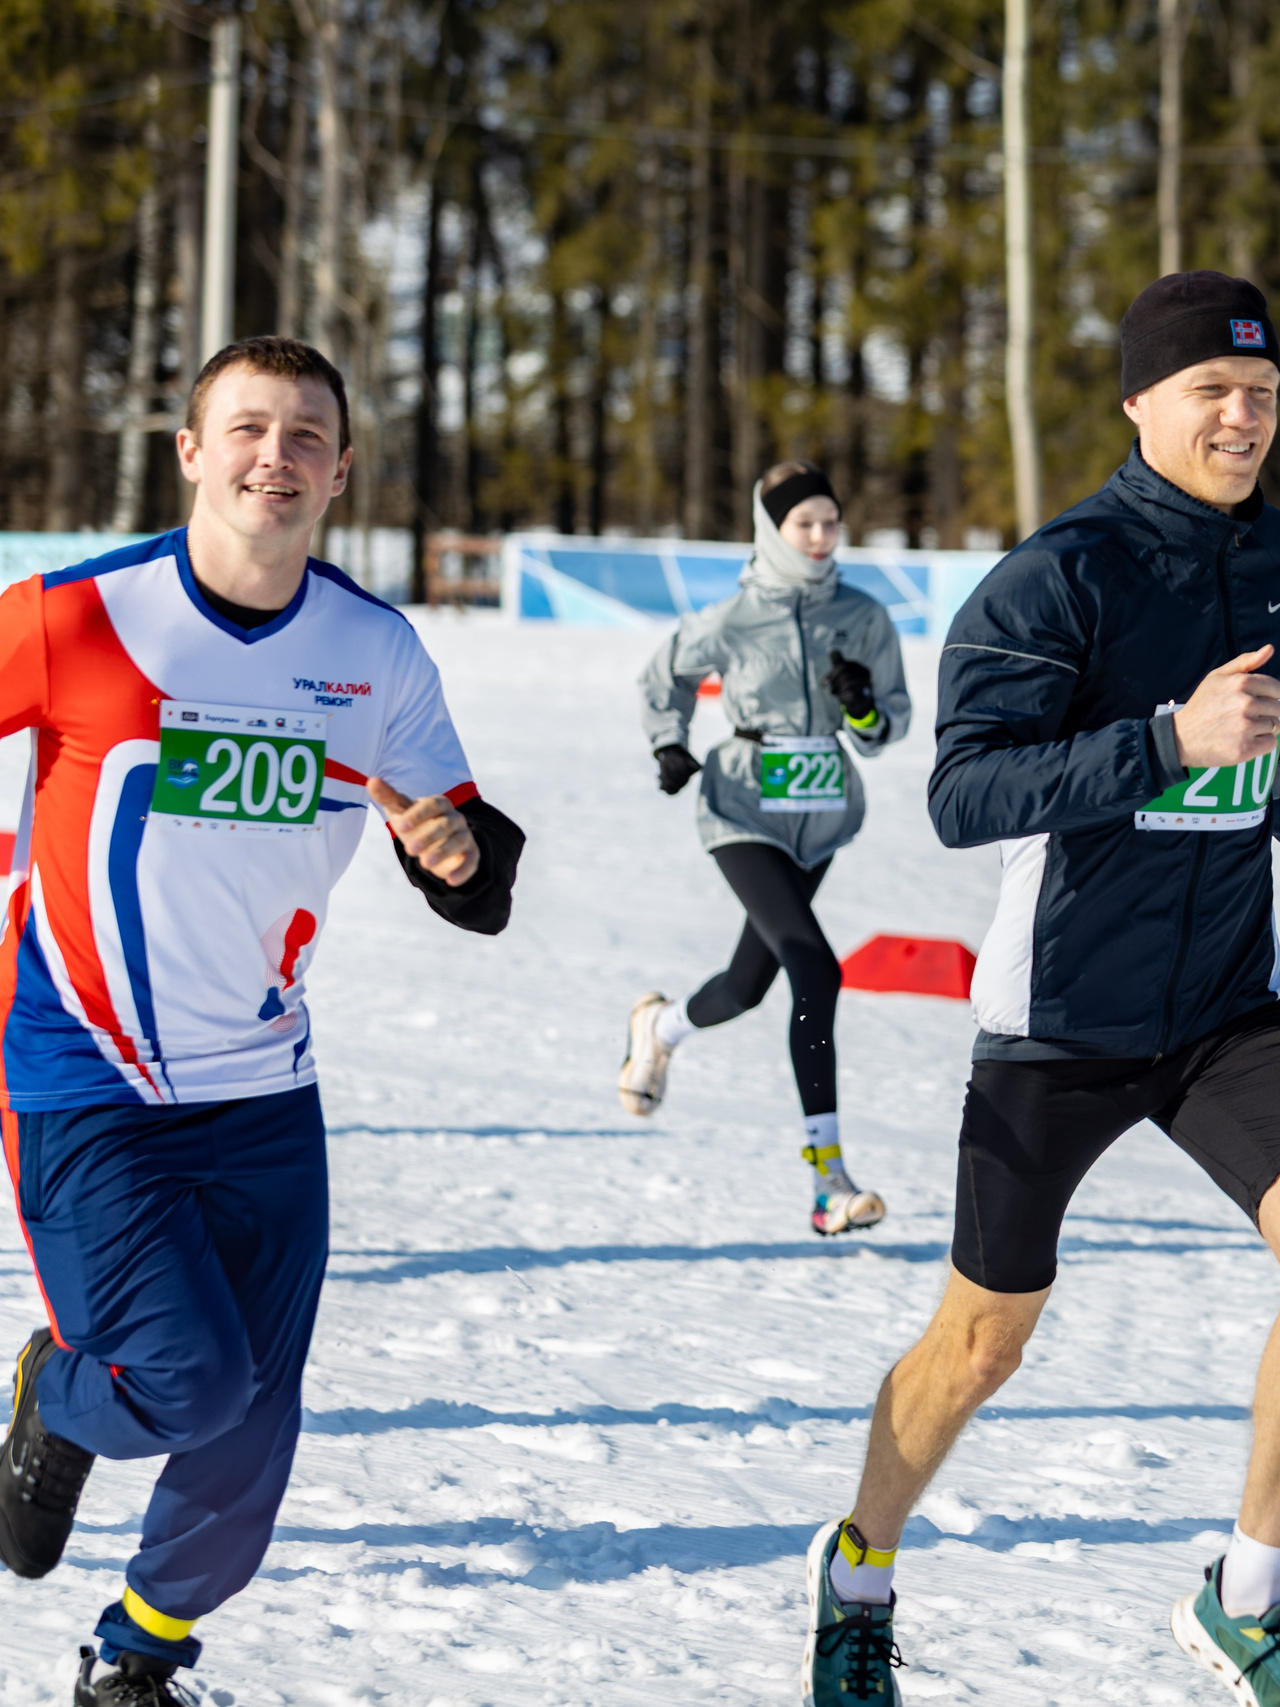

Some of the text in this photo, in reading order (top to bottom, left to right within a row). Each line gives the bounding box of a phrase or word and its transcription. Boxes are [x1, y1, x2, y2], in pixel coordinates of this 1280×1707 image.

[293, 678, 372, 696] УРАЛКАЛИЙ
[315, 695, 354, 707] РЕМОНТ
[199, 738, 318, 818] 209
[787, 753, 842, 797] 222
